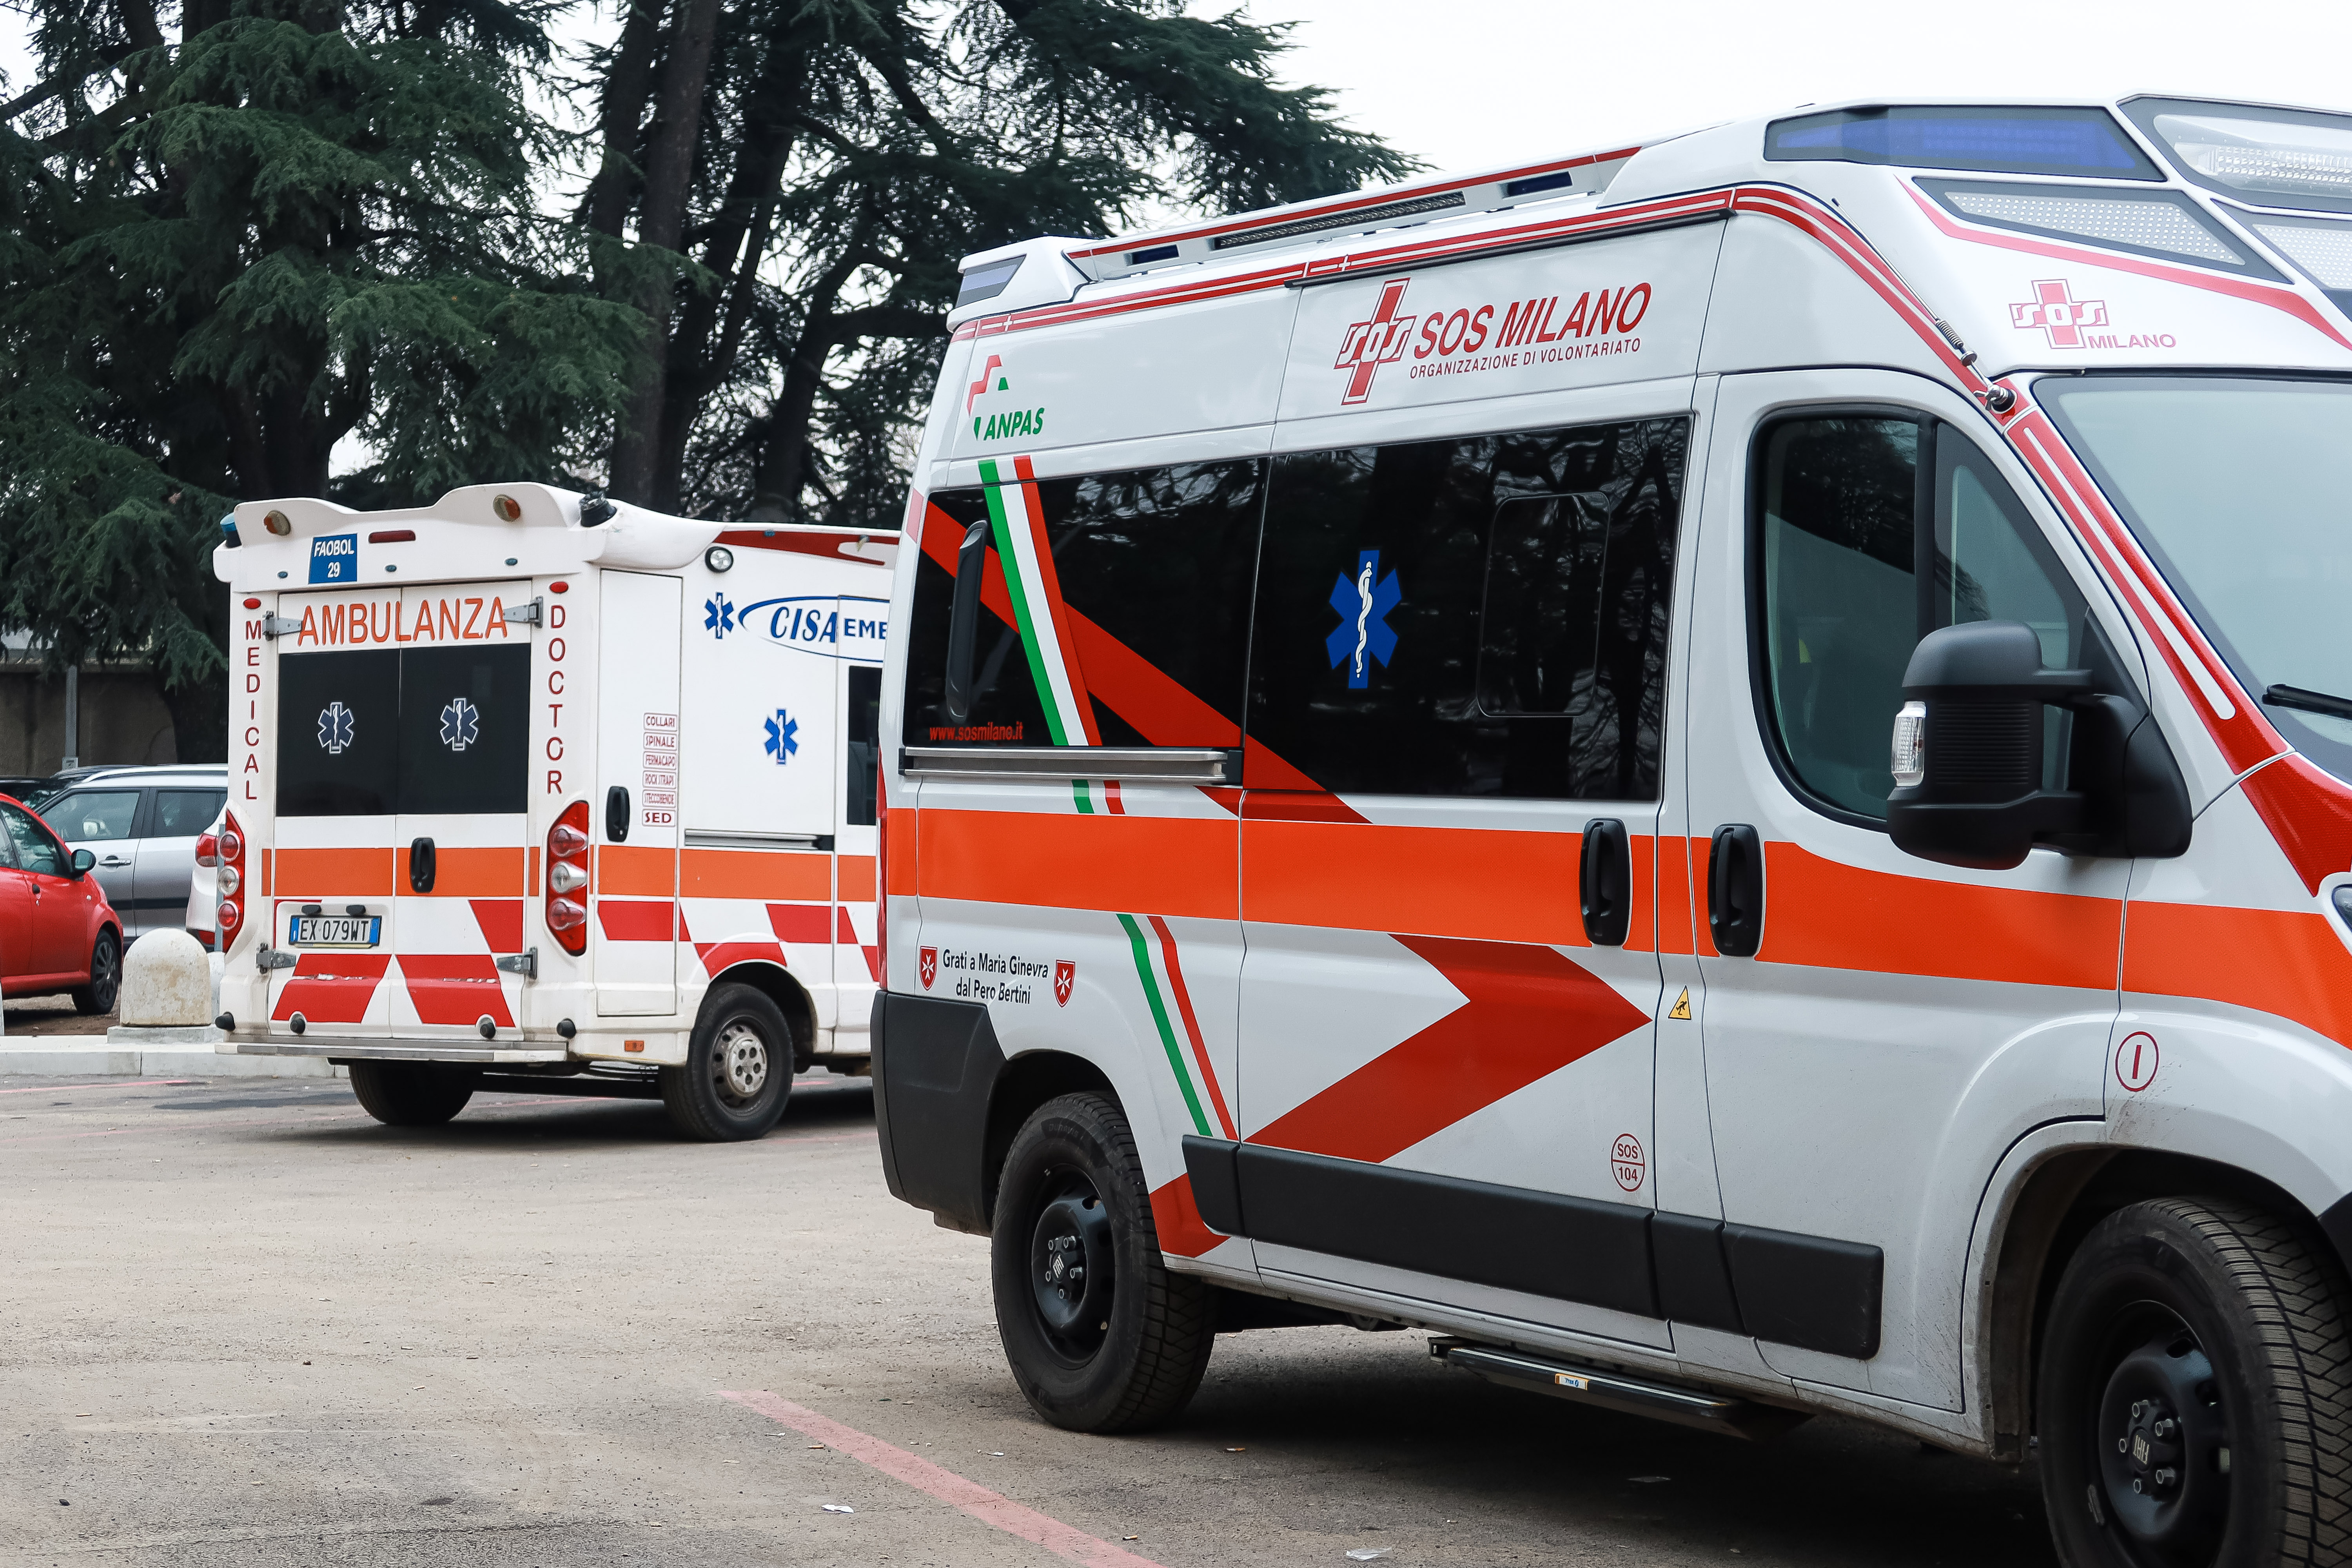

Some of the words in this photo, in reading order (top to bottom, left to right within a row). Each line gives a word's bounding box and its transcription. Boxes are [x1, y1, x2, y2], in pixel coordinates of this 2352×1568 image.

[1414, 304, 1494, 359] SOS
[1495, 282, 1652, 348] MILANO
[2012, 301, 2109, 328] SOS
[2088, 334, 2177, 349] MILANO
[1410, 354, 1518, 379] ORGANIZZAZIONE
[1523, 352, 1536, 365] DI
[1540, 338, 1641, 363] VOLONTARIATO
[984, 407, 1045, 441] ANPAS
[314, 539, 355, 557] FAOBOL
[327, 561, 341, 578] 29
[297, 597, 508, 646] AMBULANZA
[769, 606, 838, 643] CISA
[245, 620, 261, 800] MEDICAL
[547, 605, 566, 794] DOCTOR
[646, 716, 675, 727] COLLARI
[929, 721, 1024, 741] www.sosmilano.it
[646, 735, 675, 747] SPINALE
[645, 812, 671, 824] SED
[299, 920, 318, 941] EX
[322, 920, 369, 941] 079WT
[943, 949, 967, 969] Grati
[969, 957, 975, 971] a
[978, 953, 1006, 974] Maria
[1009, 955, 1049, 979] Ginevra
[956, 976, 971, 998] dal
[973, 979, 996, 1000] Pero
[998, 982, 1031, 1004] Bertini
[1617, 1143, 1638, 1160] SOS
[1618, 1167, 1638, 1182] 104
[1053, 1254, 1064, 1278] FIAT
